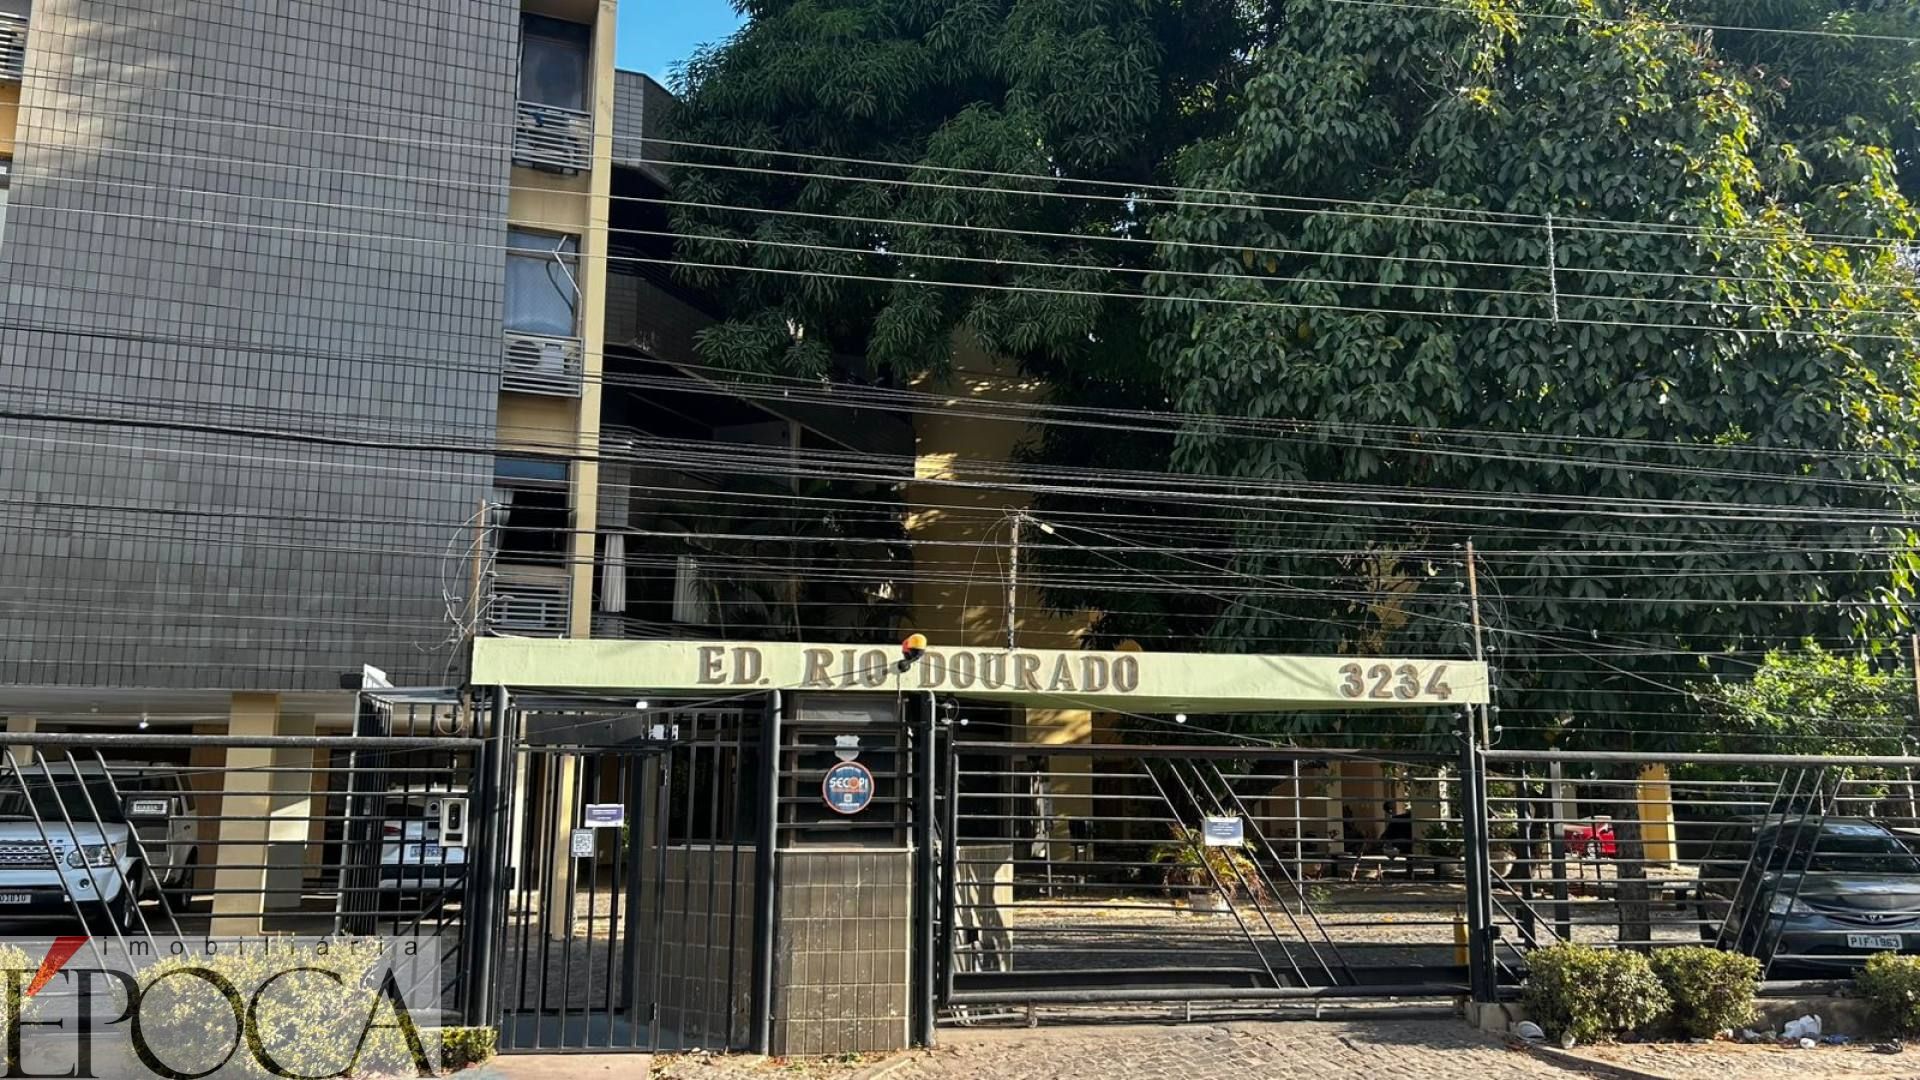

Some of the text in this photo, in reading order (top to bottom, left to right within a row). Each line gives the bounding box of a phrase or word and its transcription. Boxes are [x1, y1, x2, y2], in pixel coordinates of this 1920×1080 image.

[697, 646, 1139, 692] ED. RIO DOURADO
[1338, 662, 1453, 700] 3234
[828, 777, 869, 789] SECOPI
